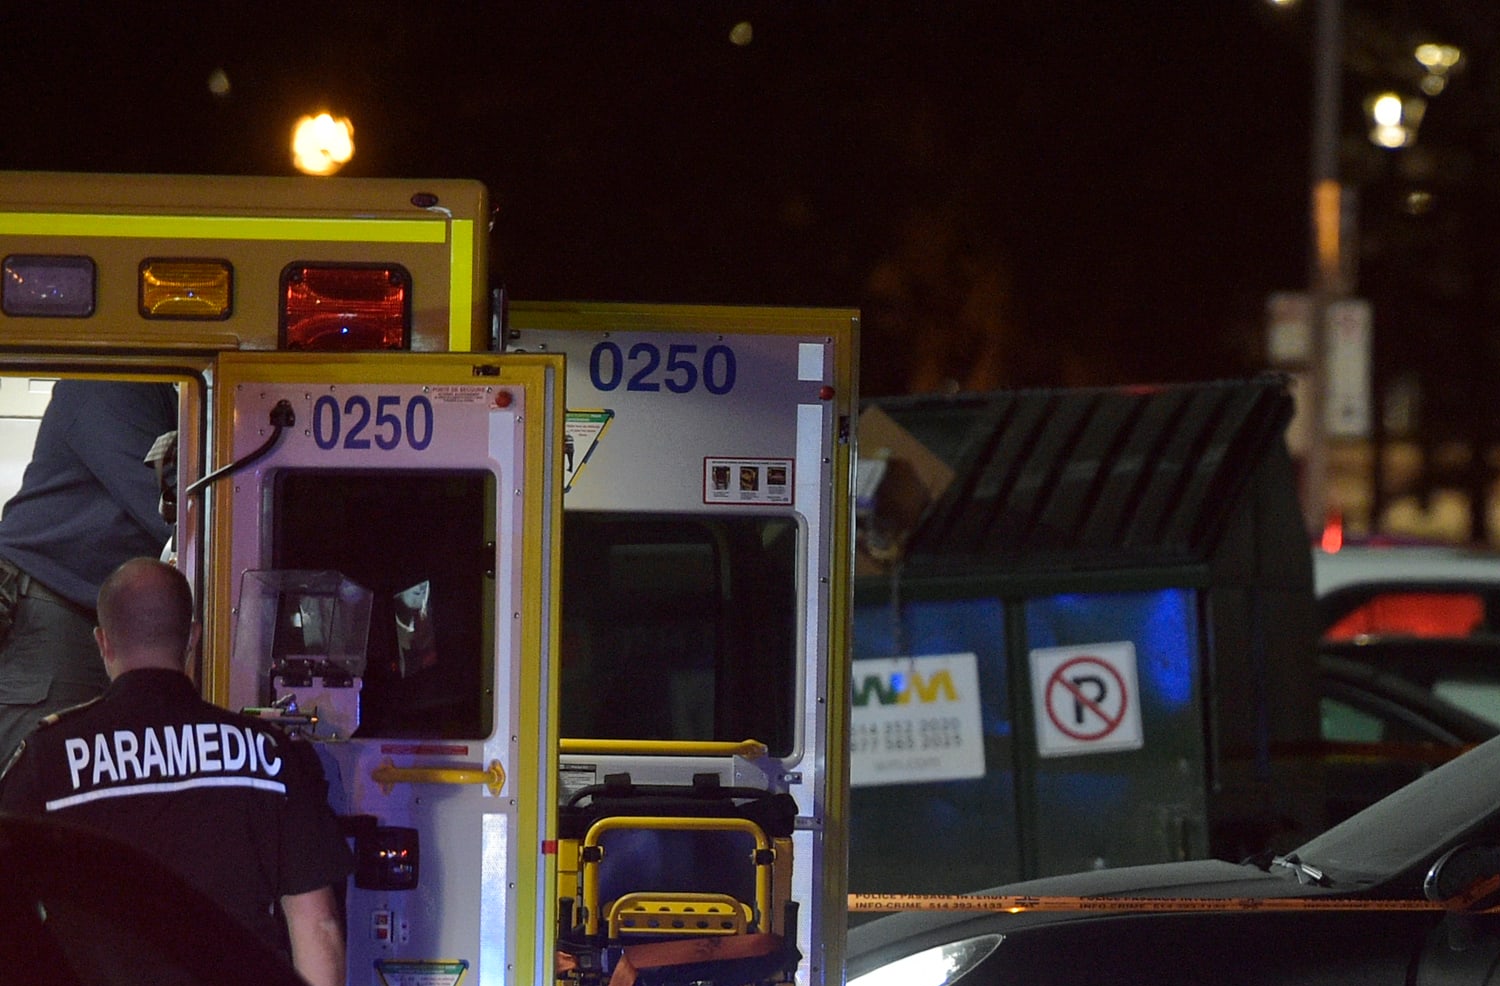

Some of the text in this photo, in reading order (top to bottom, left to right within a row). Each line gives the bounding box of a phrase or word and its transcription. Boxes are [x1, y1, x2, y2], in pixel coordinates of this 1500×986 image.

[590, 341, 737, 395] 0250
[313, 394, 434, 451] 0250
[65, 723, 282, 790] PARAMEDIC
